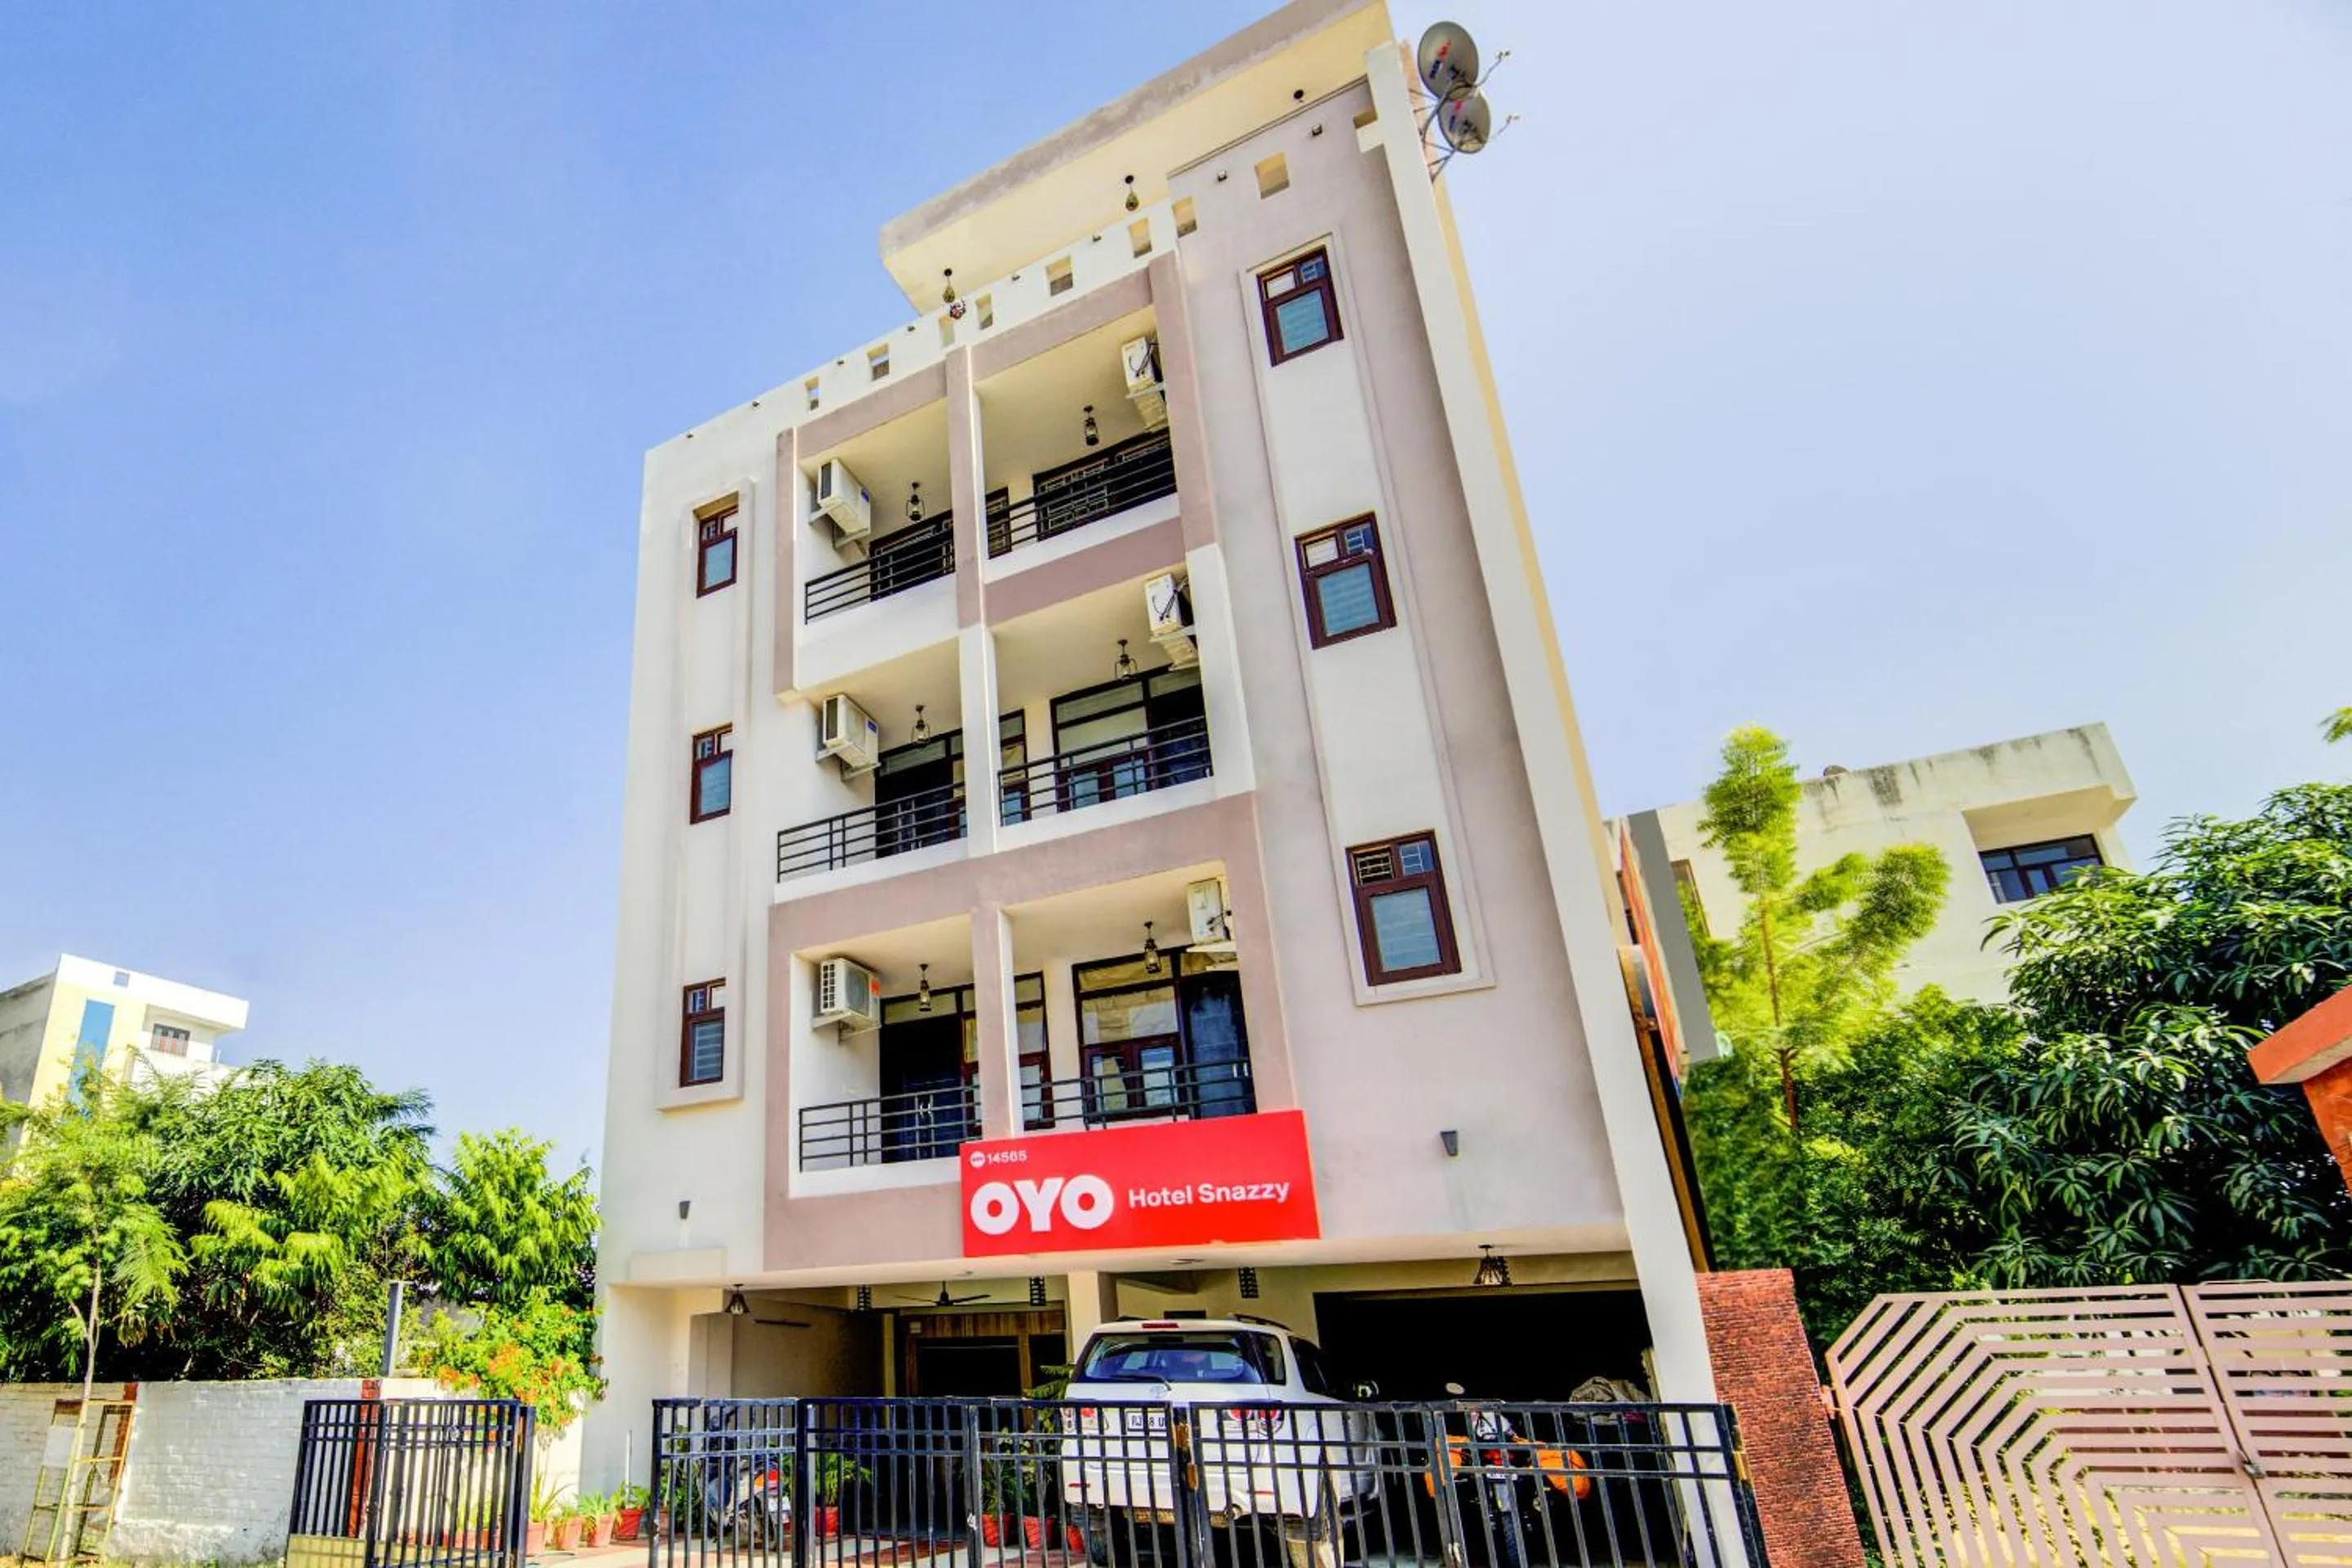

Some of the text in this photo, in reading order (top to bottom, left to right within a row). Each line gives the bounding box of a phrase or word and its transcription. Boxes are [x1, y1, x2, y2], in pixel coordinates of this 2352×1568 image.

[969, 1174, 1115, 1235] OYO
[1128, 1182, 1290, 1209] Hotel Snazzy
